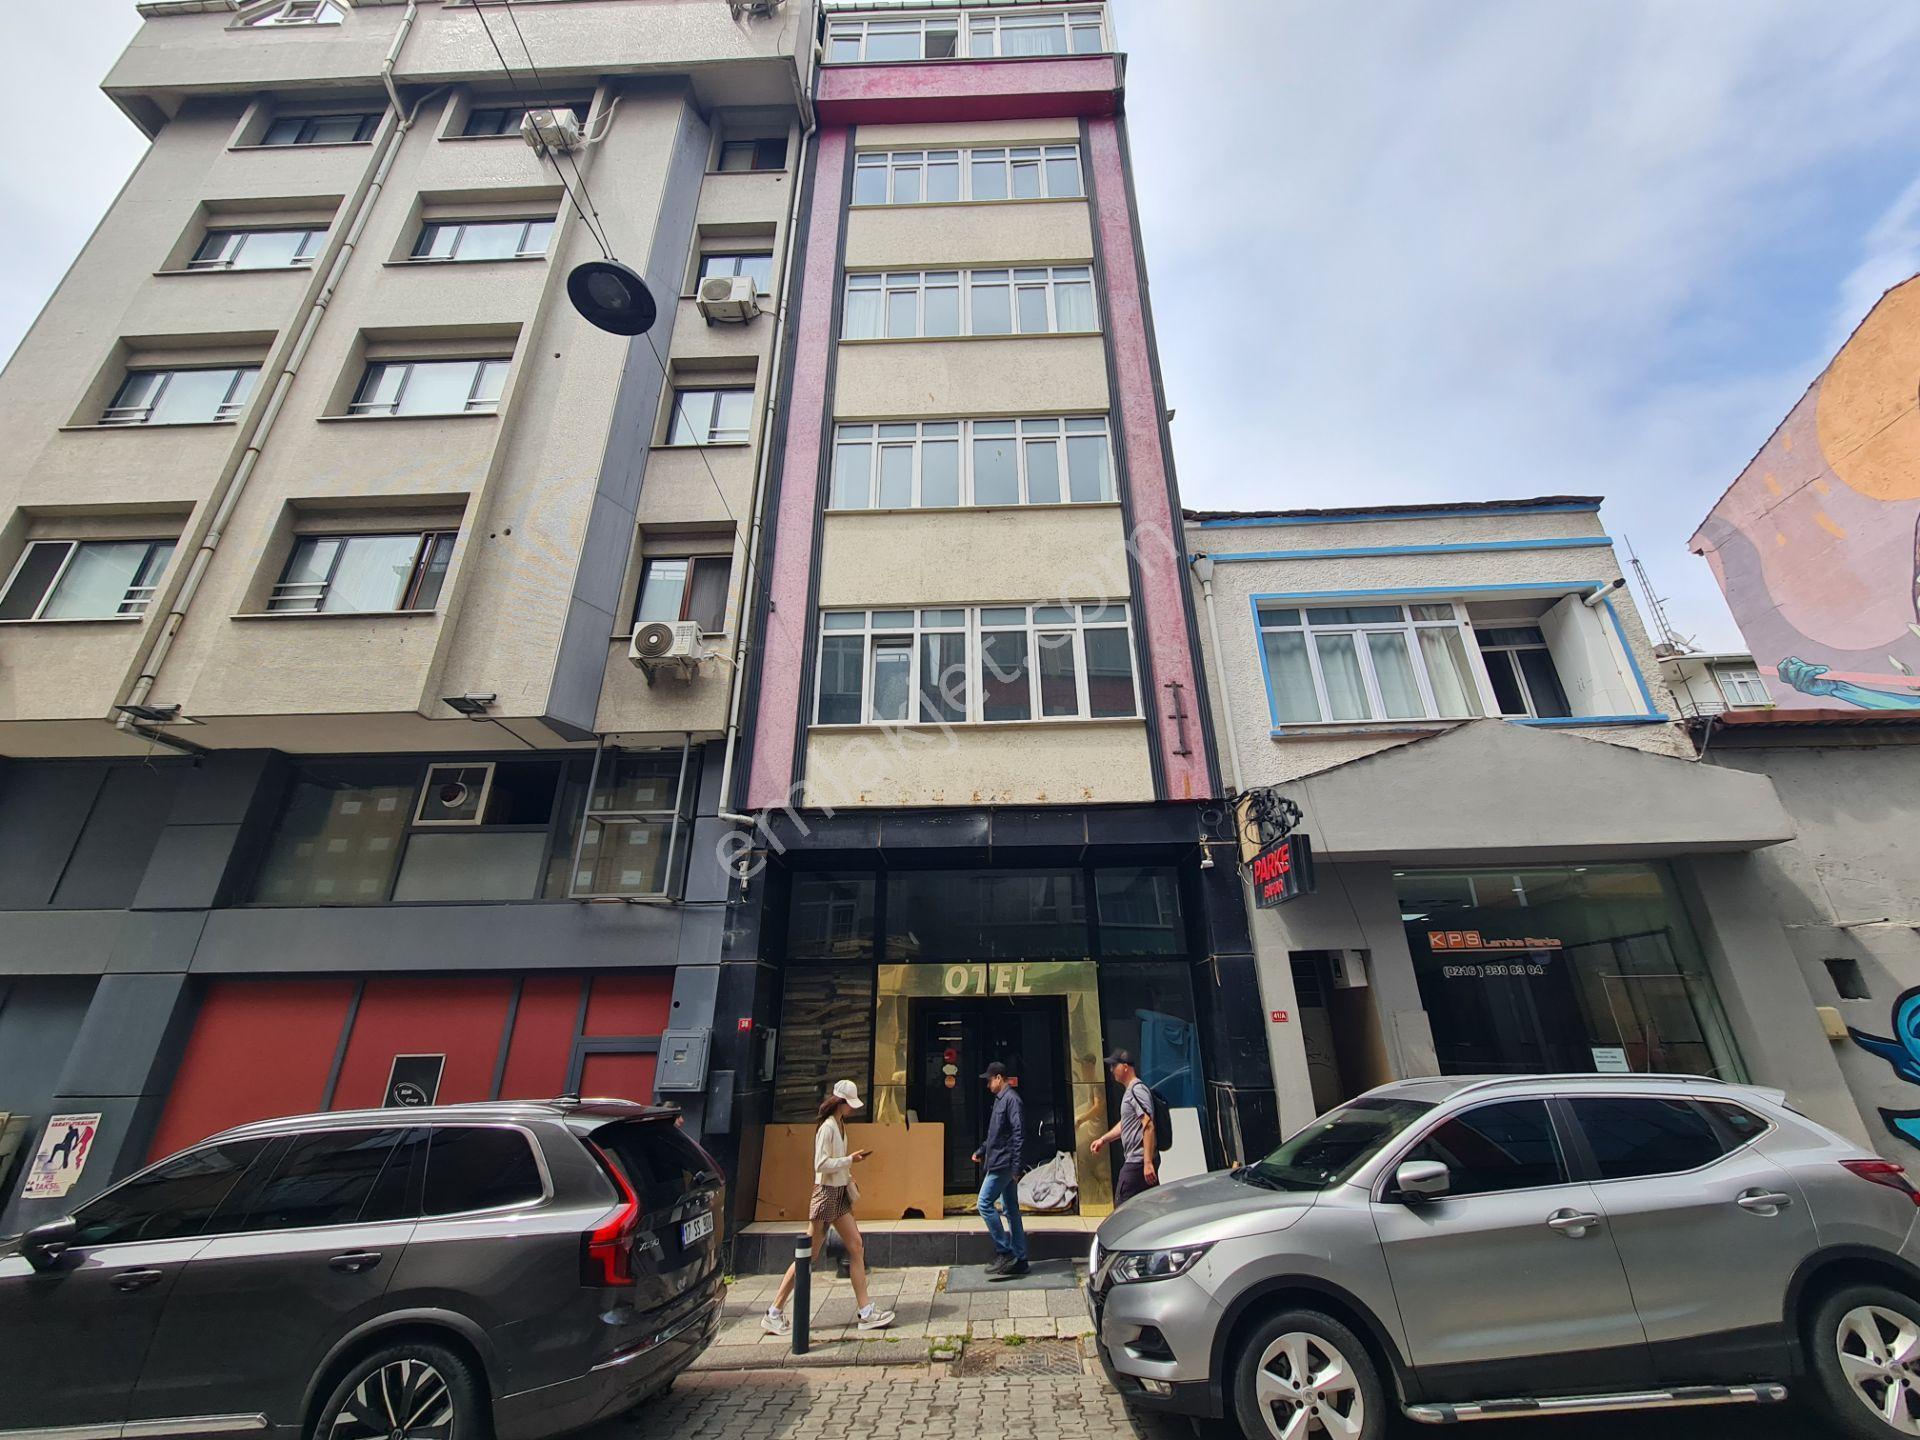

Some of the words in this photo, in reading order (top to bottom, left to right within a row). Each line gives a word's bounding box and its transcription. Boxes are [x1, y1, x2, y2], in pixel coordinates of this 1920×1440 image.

[1254, 843, 1290, 885] PARKE
[1429, 931, 1481, 948] KPS
[945, 965, 1032, 994] OTEL
